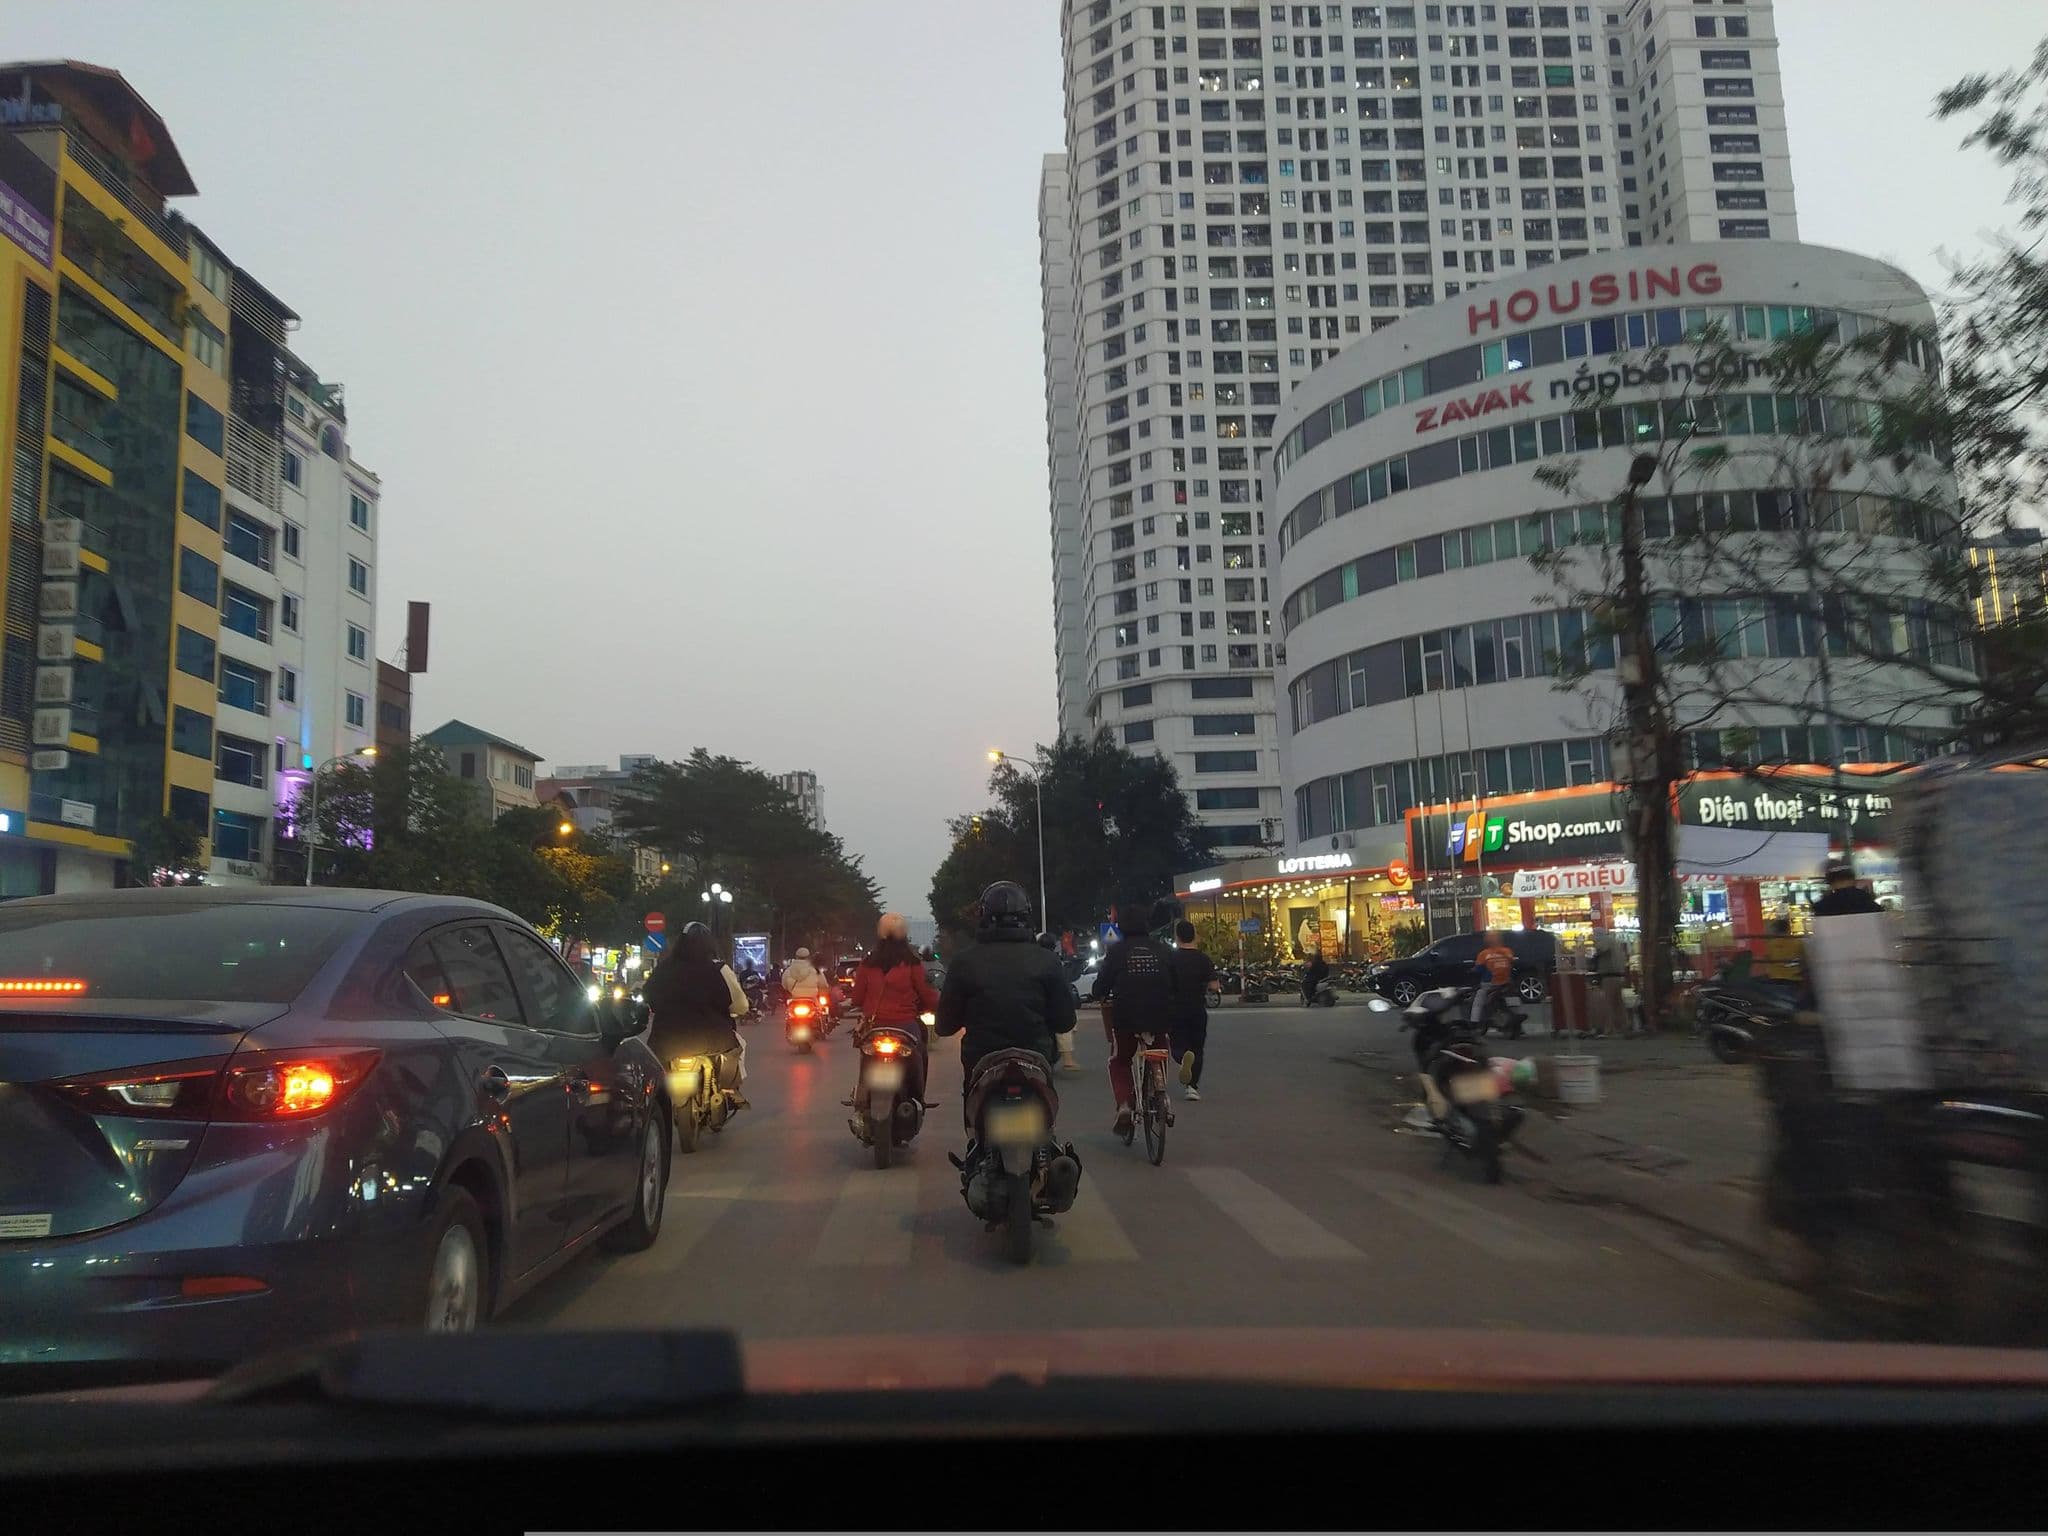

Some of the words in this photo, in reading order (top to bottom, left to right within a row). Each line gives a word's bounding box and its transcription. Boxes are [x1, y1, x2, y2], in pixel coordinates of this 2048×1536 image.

[1468, 264, 1723, 334] HOUSING
[1415, 379, 1535, 433] ZAVAK
[1699, 795, 1748, 828] Điện
[1819, 793, 1860, 826] My
[1447, 819, 1504, 853] FPT
[1278, 853, 1352, 873] LOTTERIA
[1538, 874, 1559, 890] 10
[1563, 866, 1625, 890] TRIỆU
